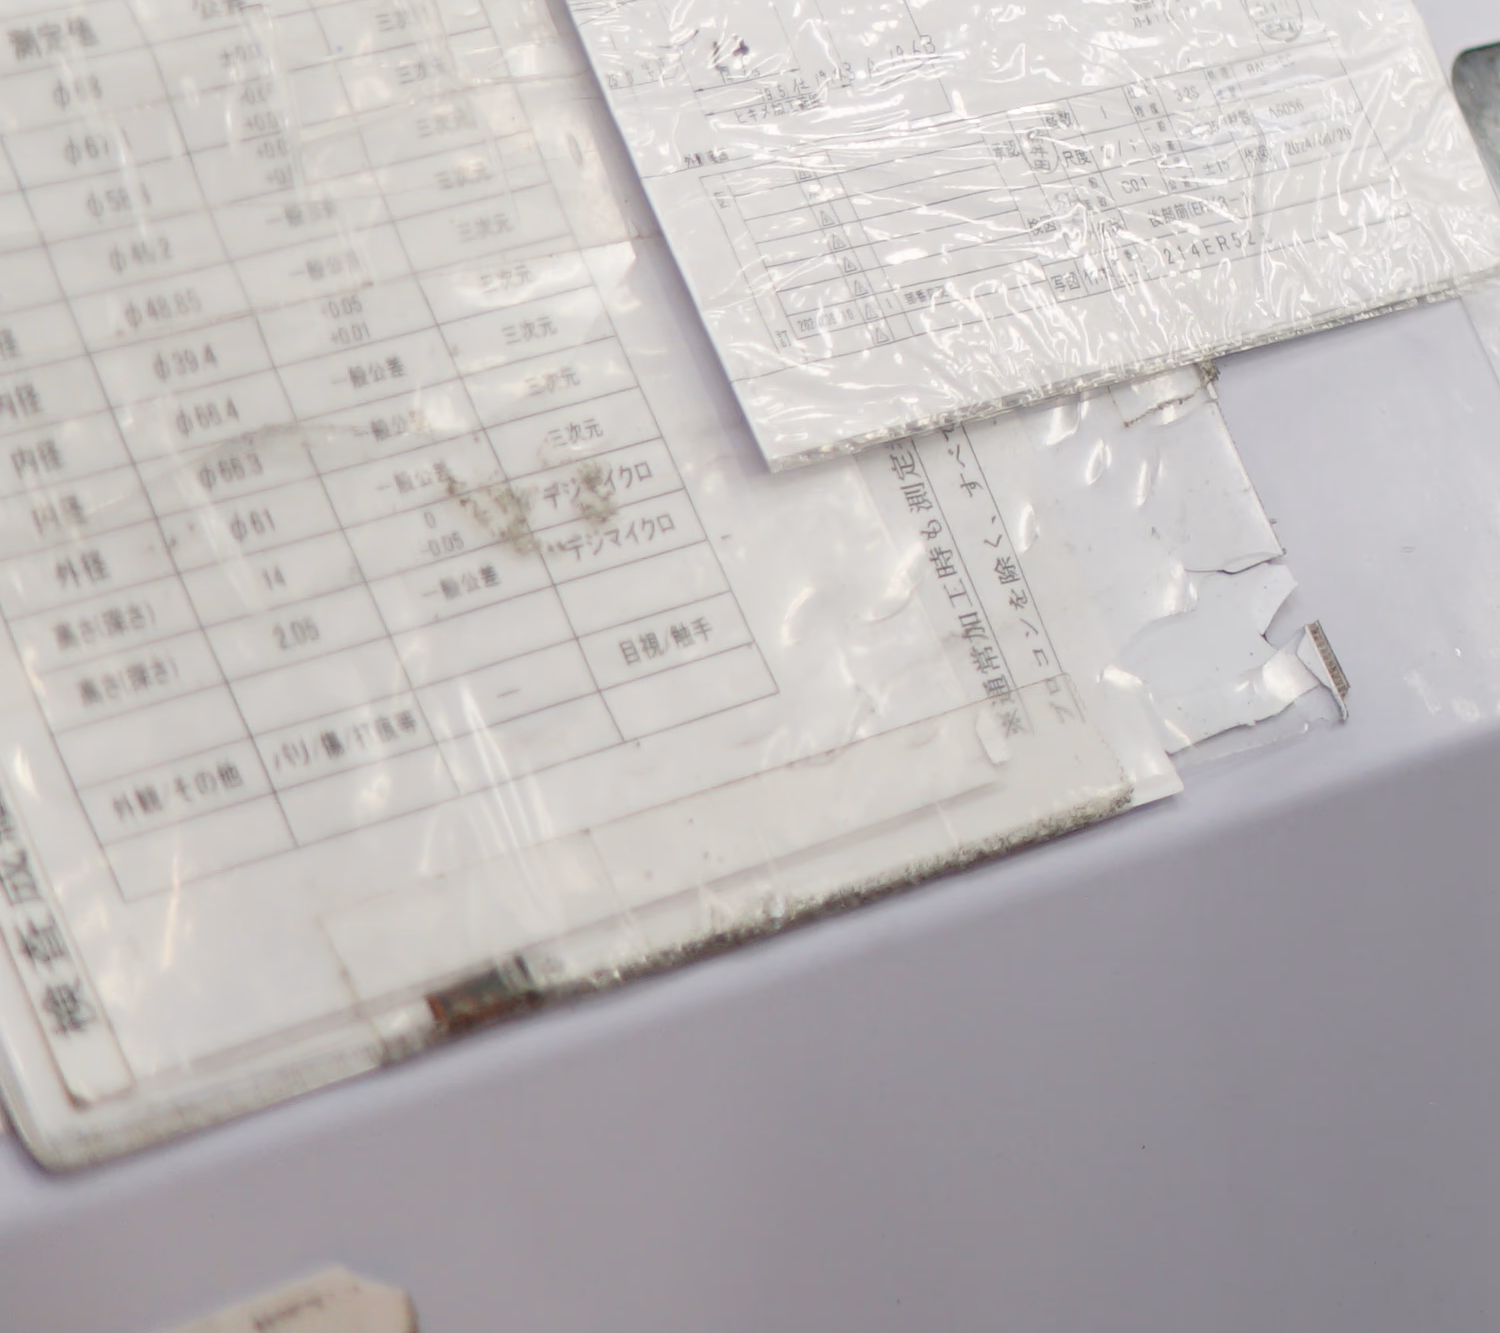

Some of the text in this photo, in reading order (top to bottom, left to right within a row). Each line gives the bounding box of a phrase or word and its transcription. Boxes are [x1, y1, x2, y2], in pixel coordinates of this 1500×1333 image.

[501, 315, 558, 346] 三次元
[523, 365, 582, 398] 三次元
[547, 417, 605, 449] 三次元
[886, 439, 1024, 739] ※通常加工時も測定
